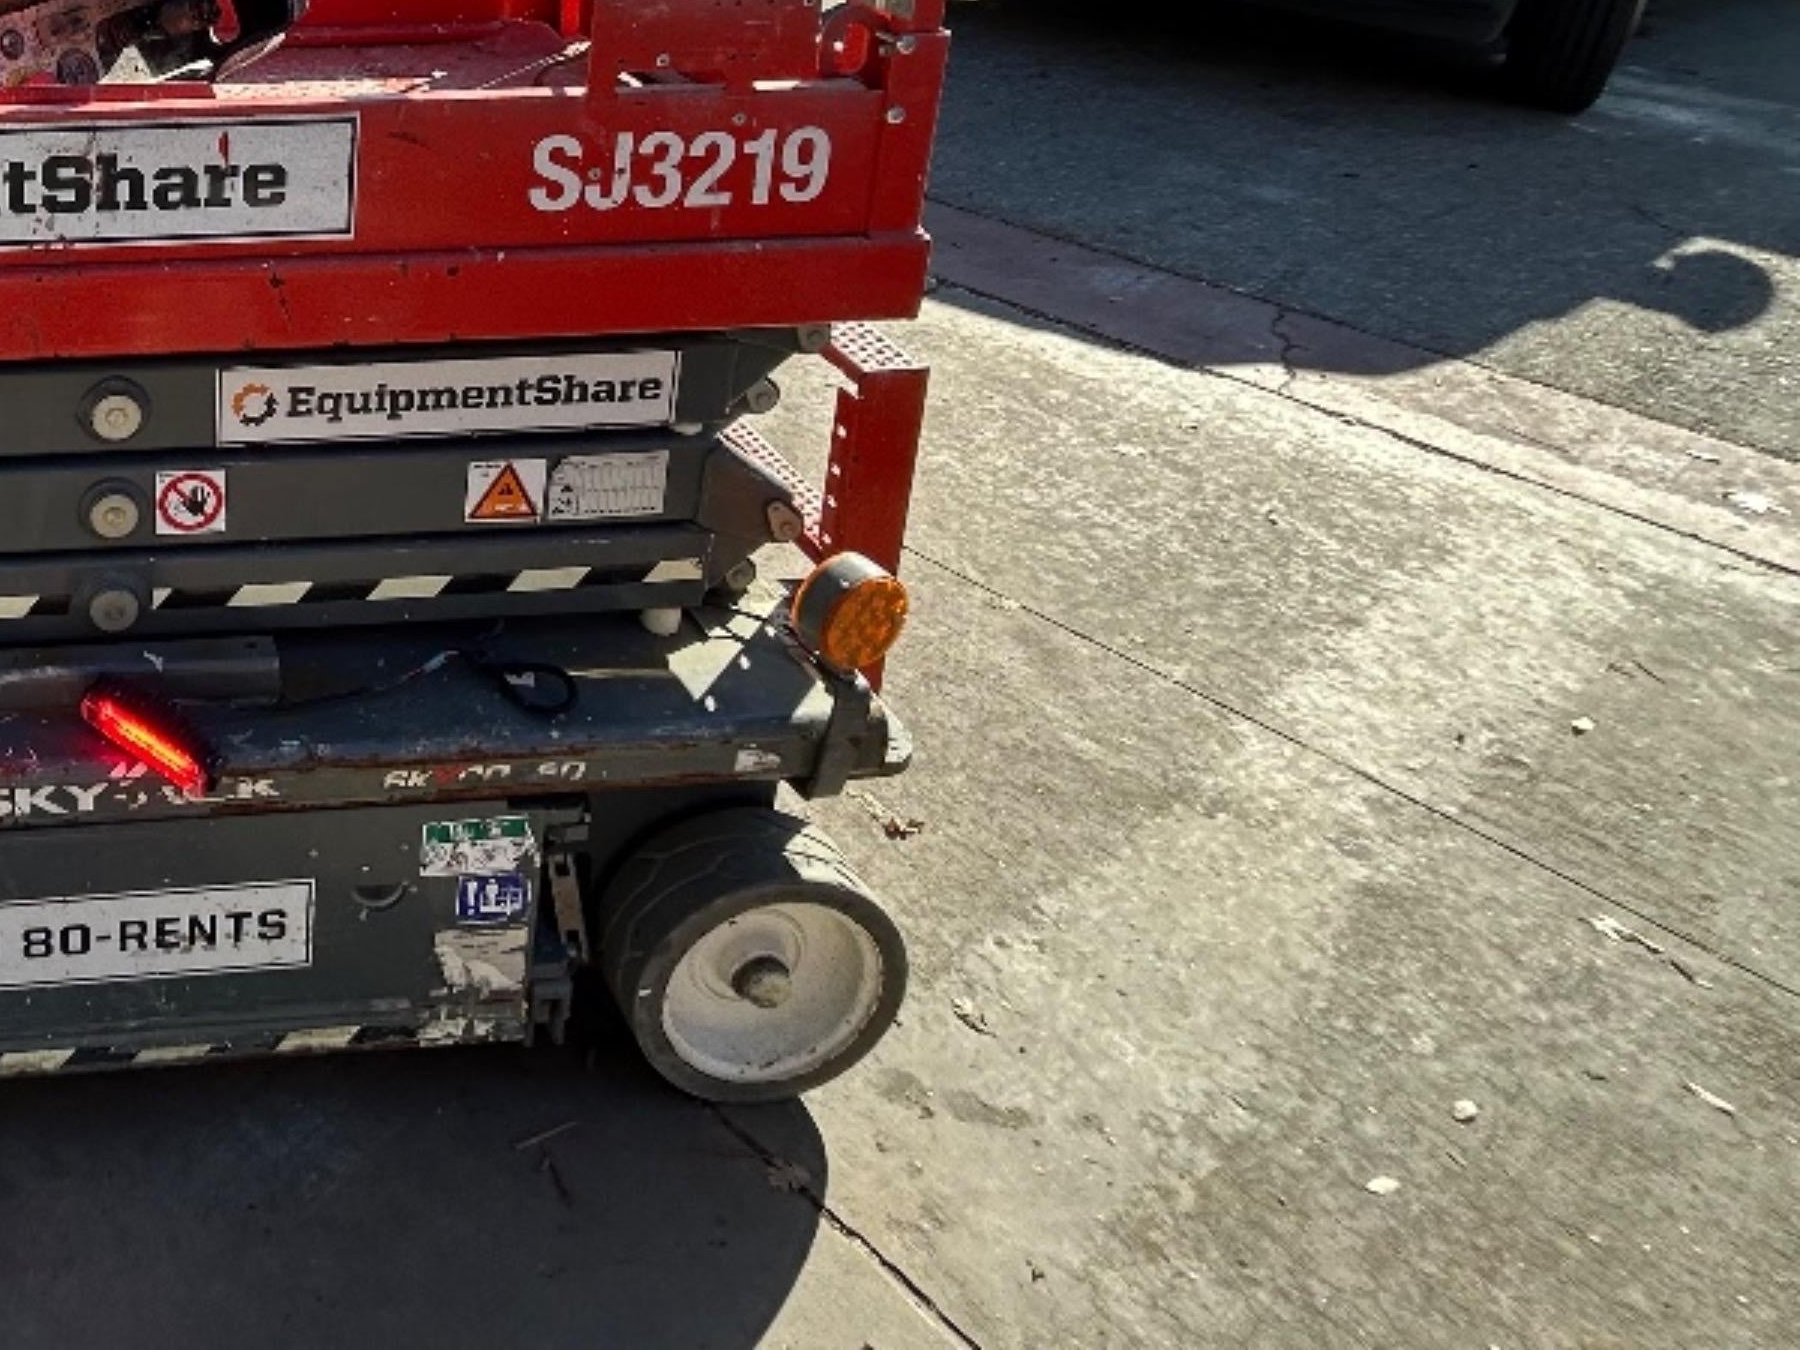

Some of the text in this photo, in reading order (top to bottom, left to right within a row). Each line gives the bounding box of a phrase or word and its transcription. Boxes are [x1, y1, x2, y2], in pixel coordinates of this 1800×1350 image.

[528, 125, 832, 211] SJ3219
[286, 374, 664, 424] EquipmentShare
[21, 907, 288, 959] 80-RENTS
